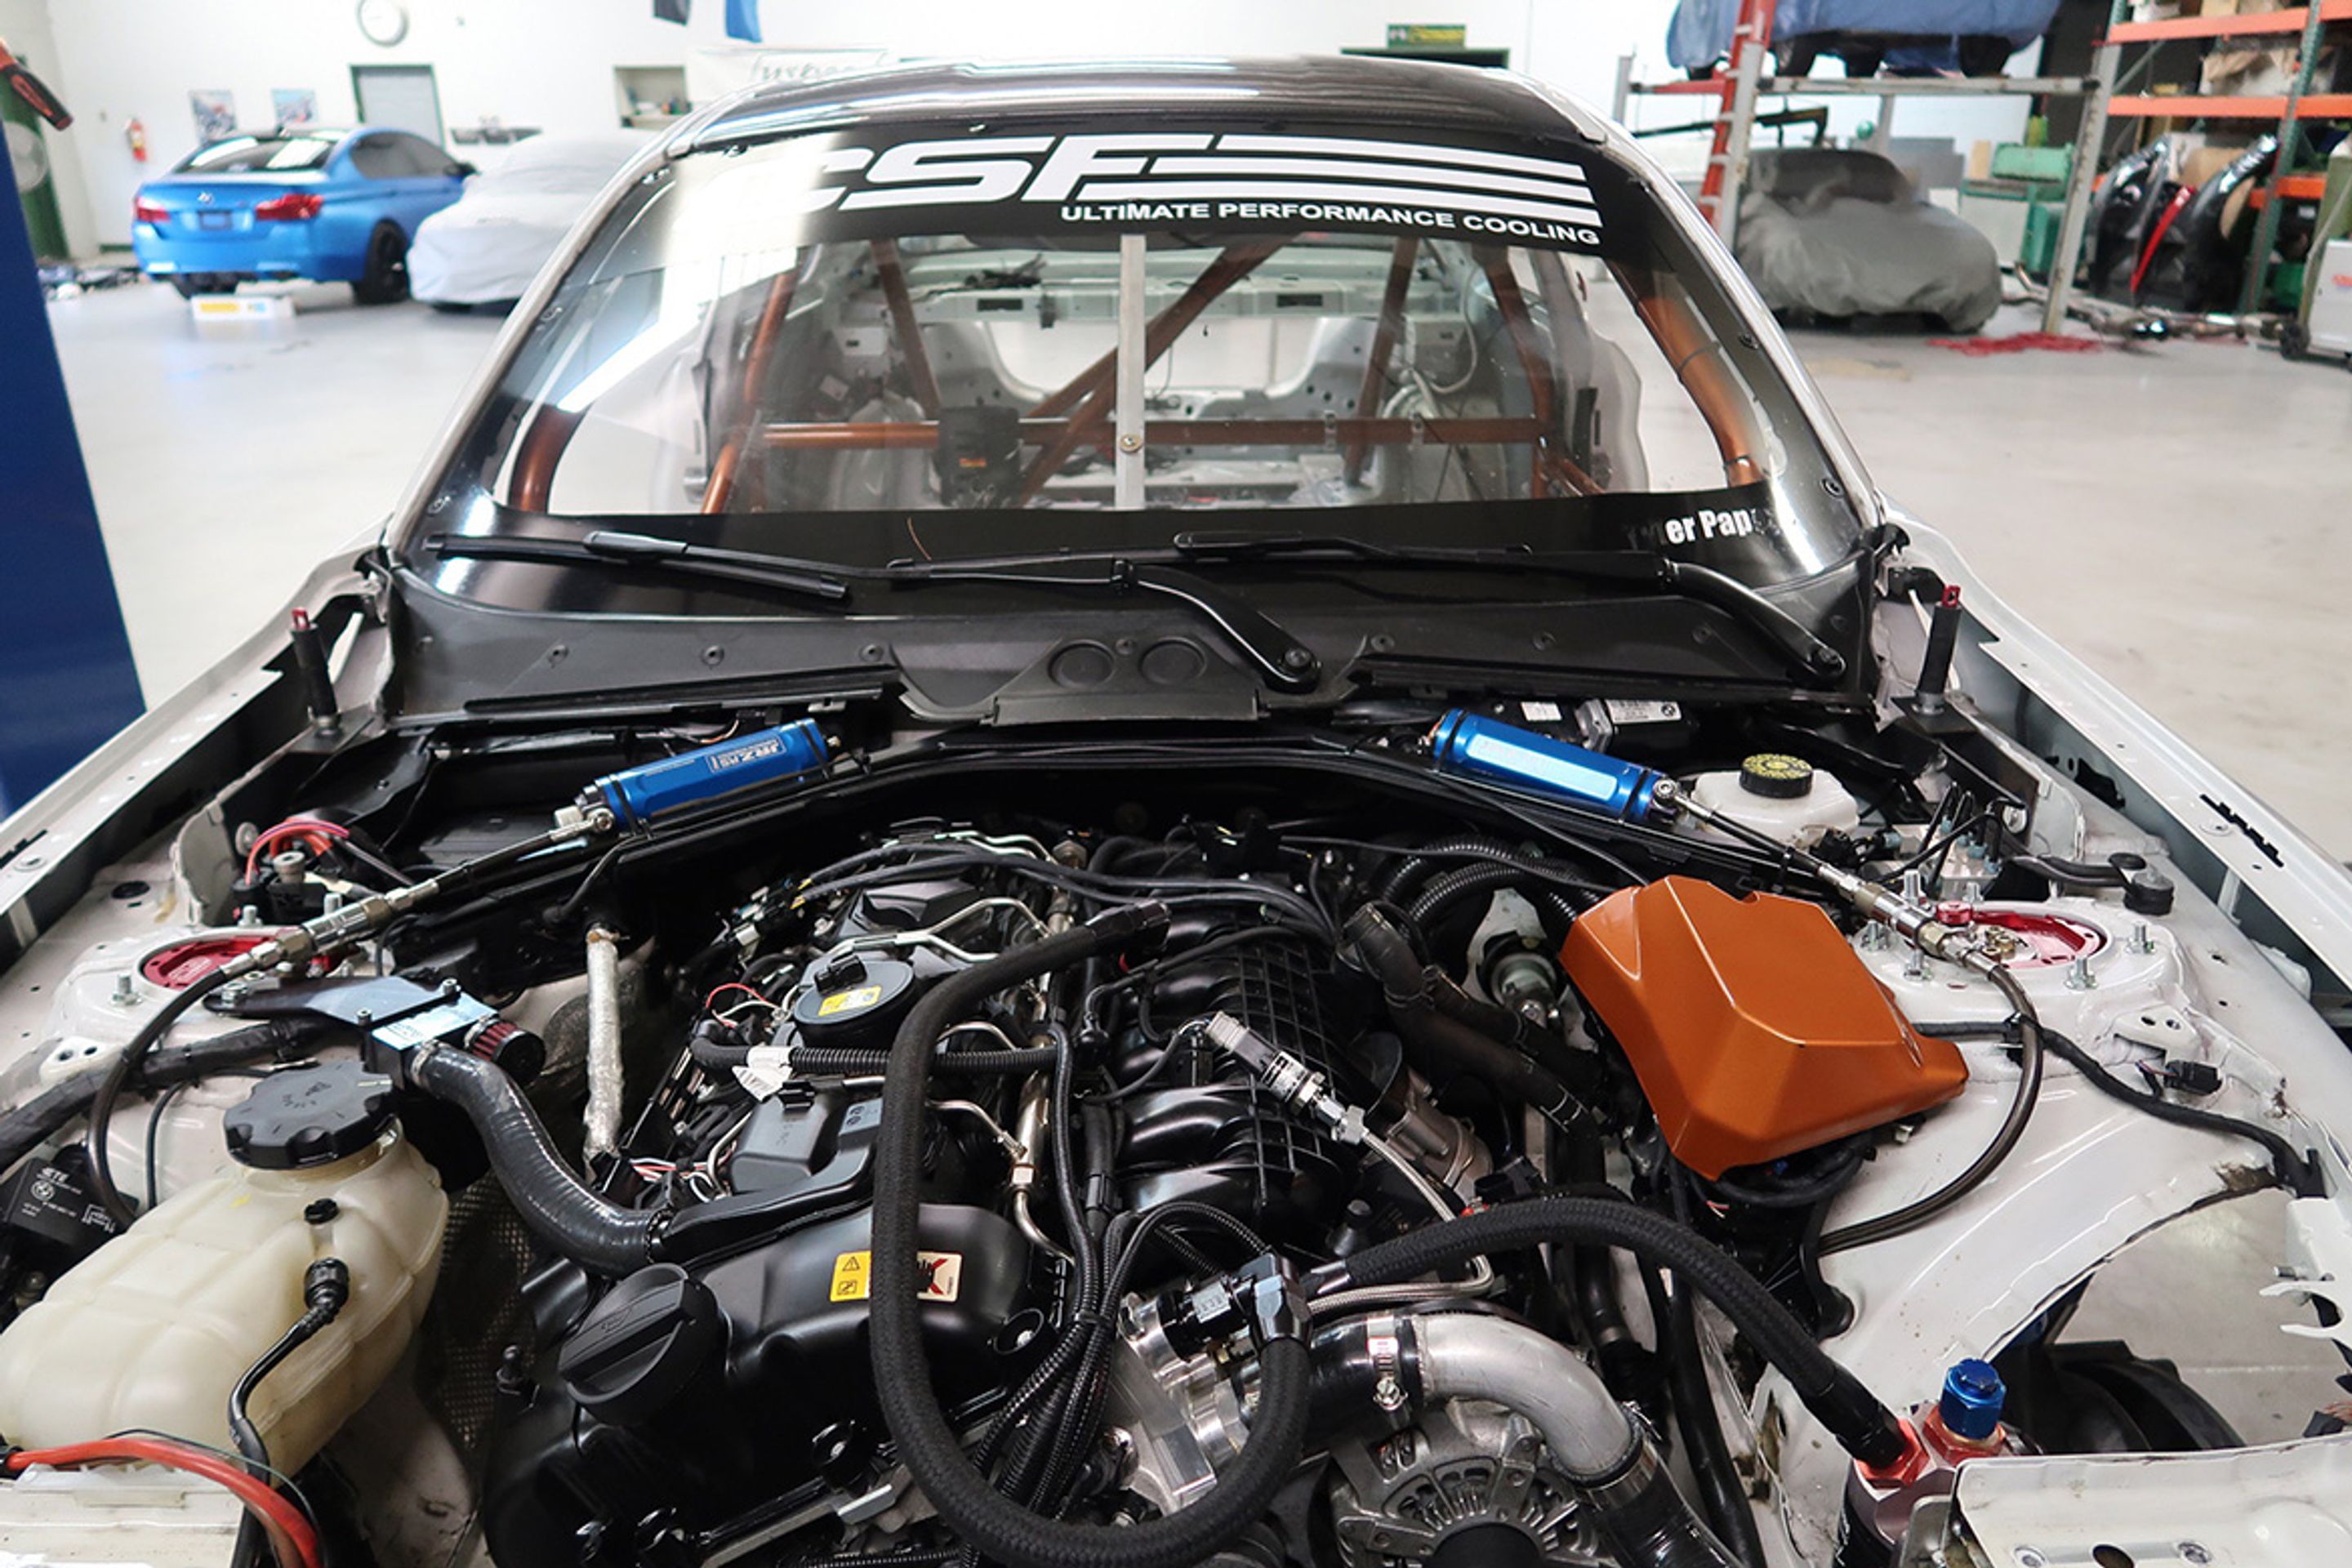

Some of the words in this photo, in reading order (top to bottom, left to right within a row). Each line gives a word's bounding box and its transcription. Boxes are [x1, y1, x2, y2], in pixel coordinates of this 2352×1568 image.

[1062, 203, 1210, 220] ULTIMATE
[1219, 203, 1456, 229] PERFORMANCE
[1463, 215, 1600, 244] COOLING
[1664, 517, 1696, 544] er
